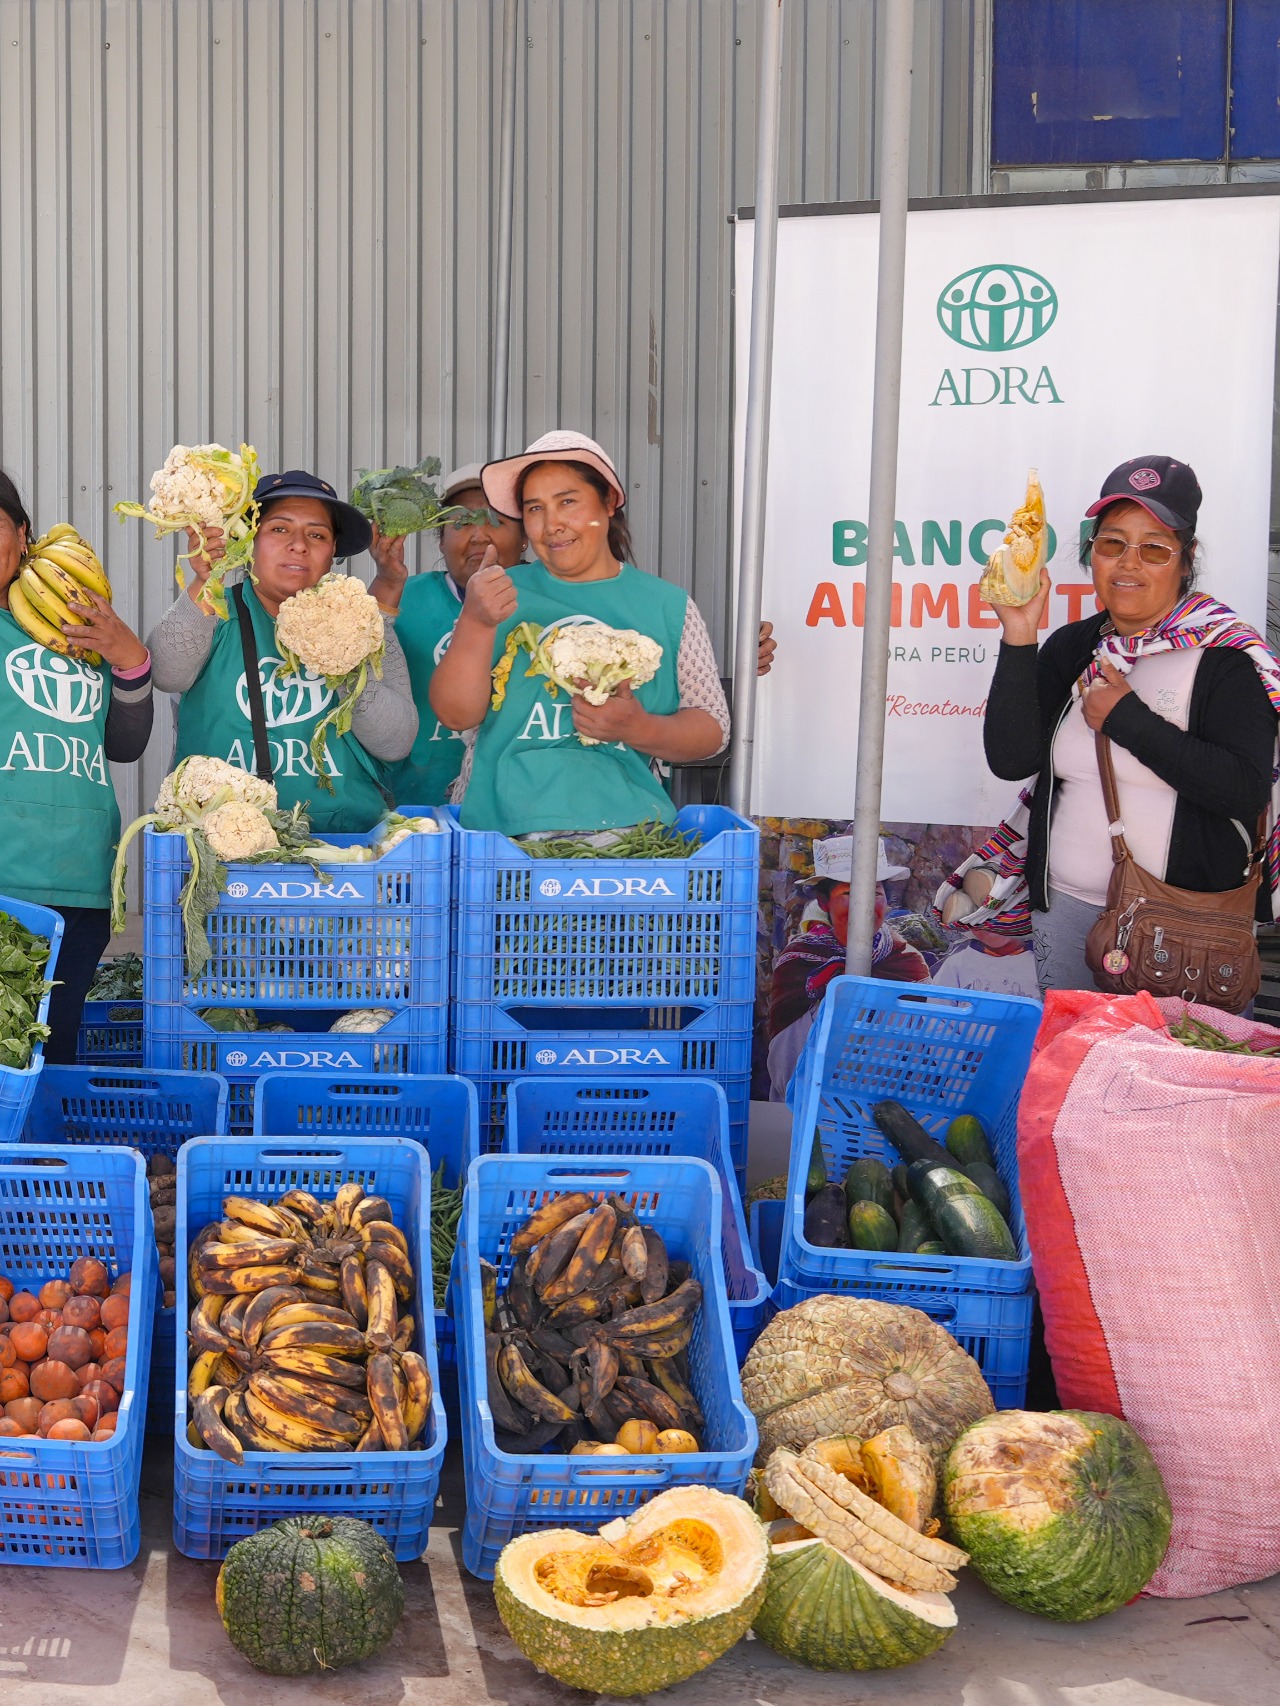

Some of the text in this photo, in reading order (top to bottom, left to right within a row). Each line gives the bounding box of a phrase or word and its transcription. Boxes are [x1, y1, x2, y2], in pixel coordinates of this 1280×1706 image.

[928, 366, 1065, 406] ADRA
[833, 519, 1057, 567] BANC
[888, 644, 986, 664] RA PERÚ
[886, 695, 988, 717] “Rescatand
[0, 731, 108, 787] ADRA
[250, 881, 364, 899] ADRA
[563, 877, 676, 897] ADRA
[250, 1050, 362, 1068] ADRA
[557, 1048, 670, 1066] ADRA
